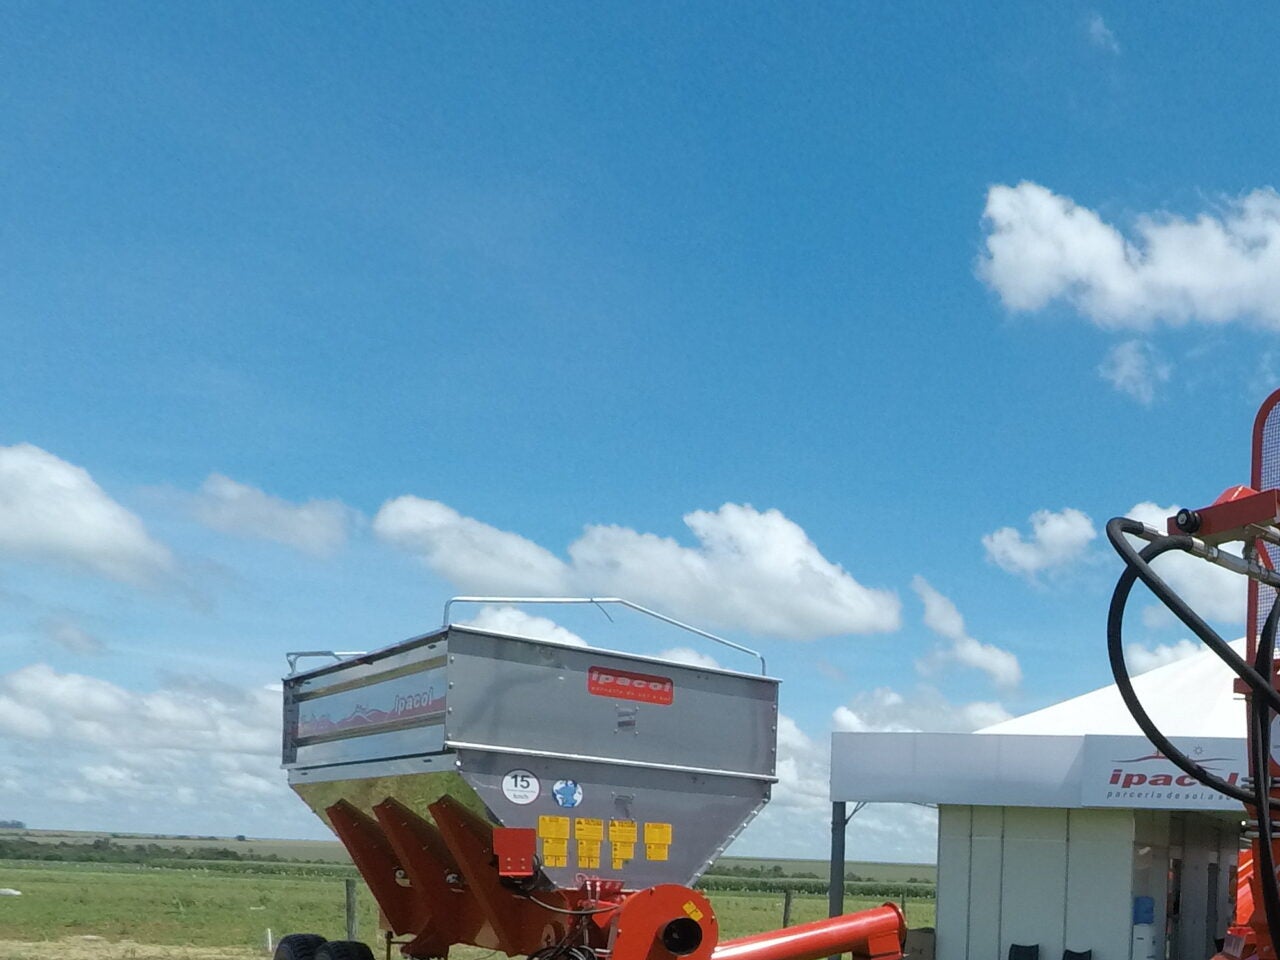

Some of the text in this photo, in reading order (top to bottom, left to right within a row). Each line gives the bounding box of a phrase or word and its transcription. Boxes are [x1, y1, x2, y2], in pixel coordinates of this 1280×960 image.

[592, 670, 672, 693] ipacol
[394, 685, 434, 716] ipacol
[511, 774, 530, 789] 15
[1109, 769, 1239, 789] ipacl
[1106, 791, 1162, 800] parceria
[1166, 791, 1180, 800] de
[1184, 792, 1204, 800] sol
